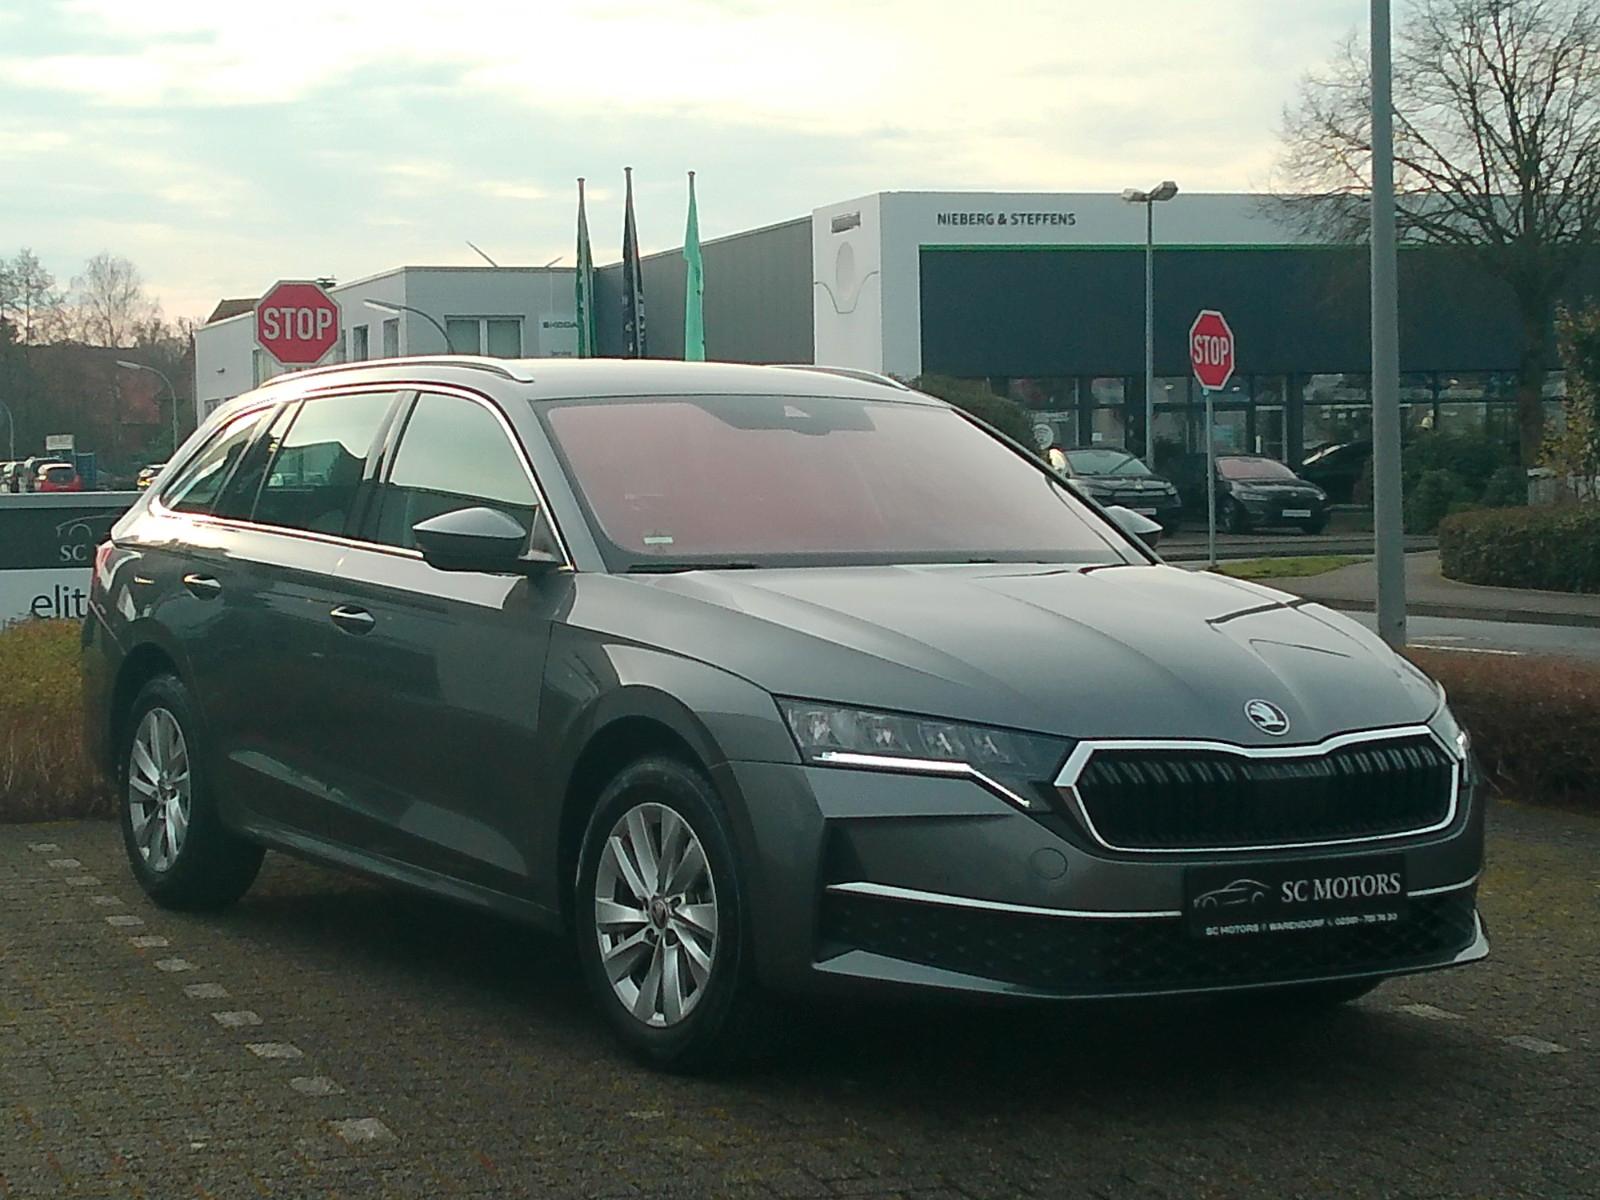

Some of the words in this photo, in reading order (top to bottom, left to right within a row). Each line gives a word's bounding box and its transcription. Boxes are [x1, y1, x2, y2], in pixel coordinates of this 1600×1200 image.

[937, 212, 995, 226] NIEBERG
[997, 213, 1007, 226] &
[1010, 212, 1077, 226] STEFFENS
[263, 307, 333, 340] STOP
[1194, 334, 1230, 366] STOP
[60, 544, 88, 562] SC
[31, 584, 88, 618] elit
[1281, 880, 1309, 903] SC
[1313, 873, 1401, 901] MOTORS
[1220, 924, 1259, 935] MOTORS
